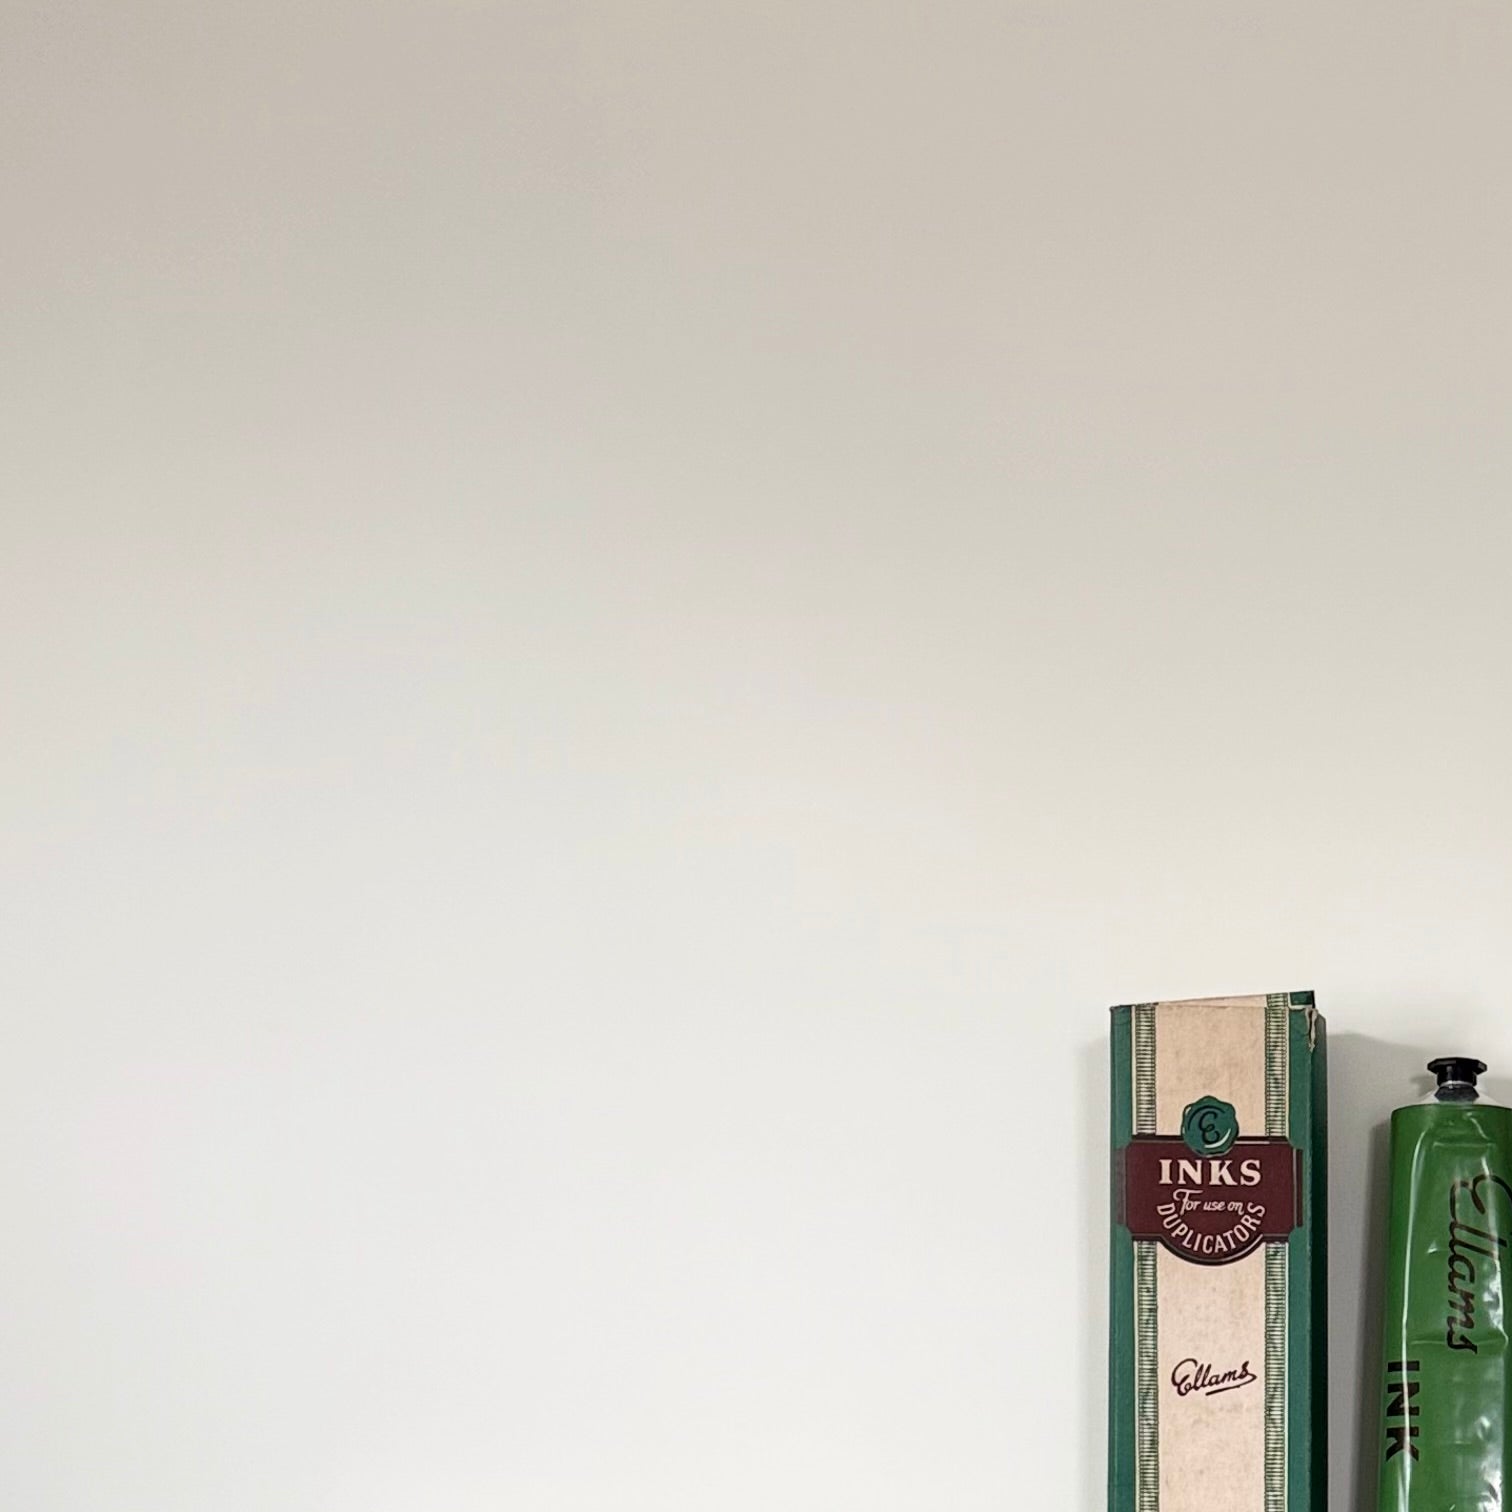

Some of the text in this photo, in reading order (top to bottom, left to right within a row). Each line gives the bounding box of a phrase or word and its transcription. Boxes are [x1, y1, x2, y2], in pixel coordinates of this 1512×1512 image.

[1159, 1159, 1262, 1187] INKS
[1172, 1188, 1245, 1216] For use on
[1156, 1202, 1266, 1255] DUPLICATORS
[1171, 1357, 1257, 1397] Ellams
[1386, 1359, 1421, 1462] INK
